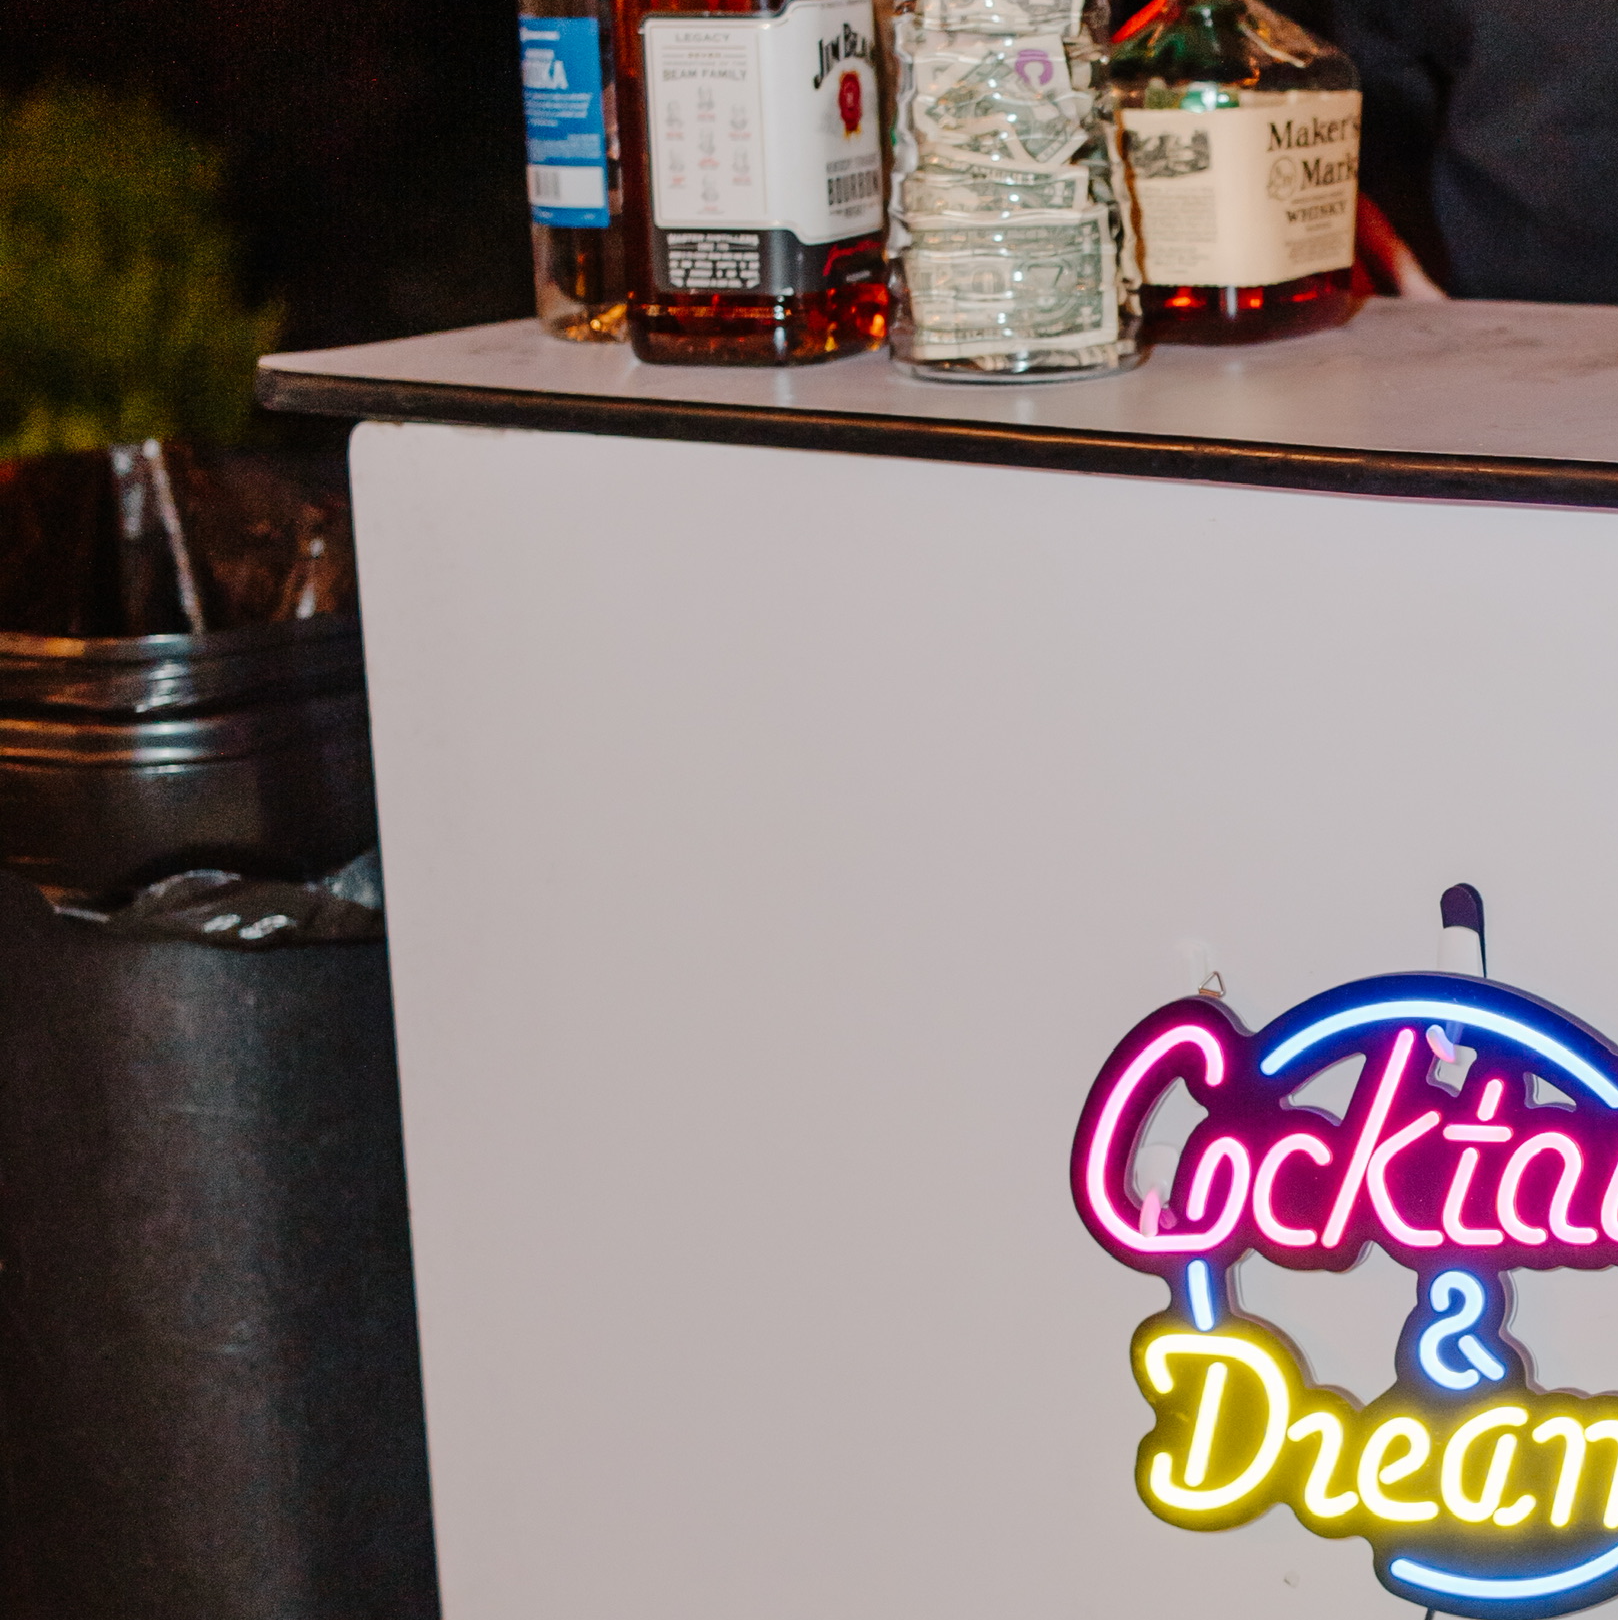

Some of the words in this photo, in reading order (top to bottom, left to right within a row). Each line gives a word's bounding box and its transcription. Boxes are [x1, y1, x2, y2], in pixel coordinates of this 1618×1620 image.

[674, 32, 730, 42] LEGACY
[661, 69, 698, 82] BEAM
[702, 69, 747, 82] FAMILY
[813, 36, 840, 90] JIM
[827, 170, 880, 206] BOURBON
[1286, 199, 1348, 223] WHISKY
[1418, 1269, 1507, 1392] &
